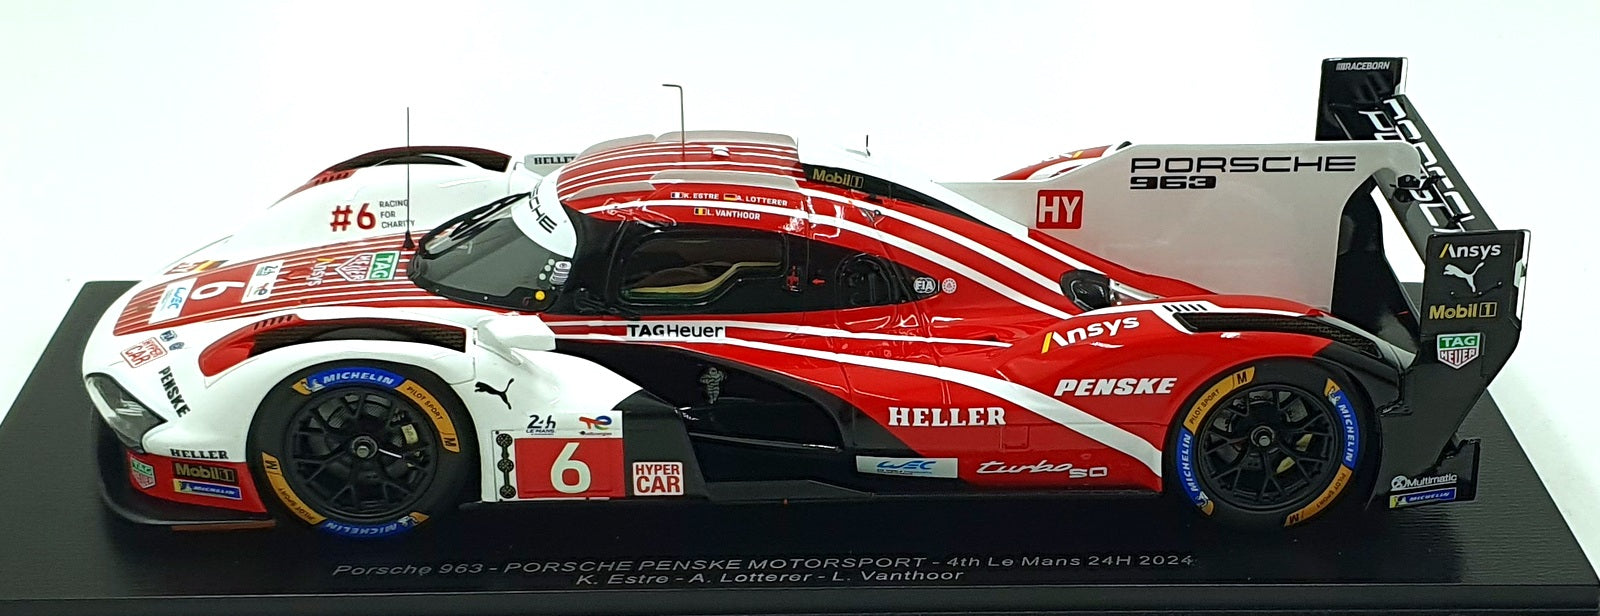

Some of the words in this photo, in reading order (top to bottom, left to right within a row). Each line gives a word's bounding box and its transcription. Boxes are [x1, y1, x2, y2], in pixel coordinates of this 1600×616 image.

[1343, 61, 1390, 71] RACEBORN
[1130, 156, 1357, 173] PORSCHE
[1130, 175, 1217, 190] 963
[379, 199, 408, 208] RACING
[745, 195, 788, 207] LOTTERER
[1038, 196, 1081, 223] HY
[330, 202, 377, 232] #6
[380, 211, 396, 219] FOR
[715, 209, 761, 220] VANTHOOR
[1439, 243, 1502, 260] Ansys
[371, 252, 393, 280] TAG
[190, 281, 246, 301] 6
[915, 278, 935, 292] FIA
[1429, 303, 1478, 319] Mobil
[1041, 317, 1140, 354] Ansys
[1441, 336, 1476, 347] TAG
[125, 344, 151, 366] CAR
[1440, 347, 1476, 366] HEUER
[323, 372, 394, 386] MICHELIN
[1054, 378, 1177, 397] PENSKE
[158, 365, 191, 418] PENSKE
[1190, 406, 1203, 426] PILOT
[1201, 388, 1221, 409] SPORT
[1236, 371, 1248, 385] M
[407, 386, 427, 401] PILOT
[425, 400, 443, 421] SPORT
[888, 406, 1006, 426] HELLER
[1338, 403, 1355, 463] MICHELIN
[169, 448, 229, 460] HELLER
[175, 462, 219, 480] Mobil
[550, 442, 591, 494] 6
[635, 464, 680, 476] HYPER
[876, 460, 937, 470] WEC
[976, 460, 1073, 474] turbo
[1181, 433, 1199, 493] MICHELIN
[636, 476, 681, 494] CAR
[1407, 473, 1458, 488] Multimatic
[192, 485, 236, 495] MICHELIN
[324, 522, 397, 535] MICHELIN
[332, 564, 433, 576] Porsche
[439, 563, 484, 574] 963
[504, 561, 634, 573] PORSCHE
[638, 560, 743, 571] PENSKE
[747, 558, 927, 570] MOTORSPORT
[946, 557, 980, 567] 4th
[988, 557, 1014, 567] Le
[1021, 556, 1081, 567] Mans
[1088, 555, 1132, 566] 24H
[1138, 555, 1194, 566] 2024
[576, 574, 599, 585] K.
[607, 574, 669, 584] Estre
[688, 573, 711, 583] A.
[720, 572, 813, 583] Lotterer
[832, 571, 850, 581] L.
[860, 570, 965, 581] Vanthoor
